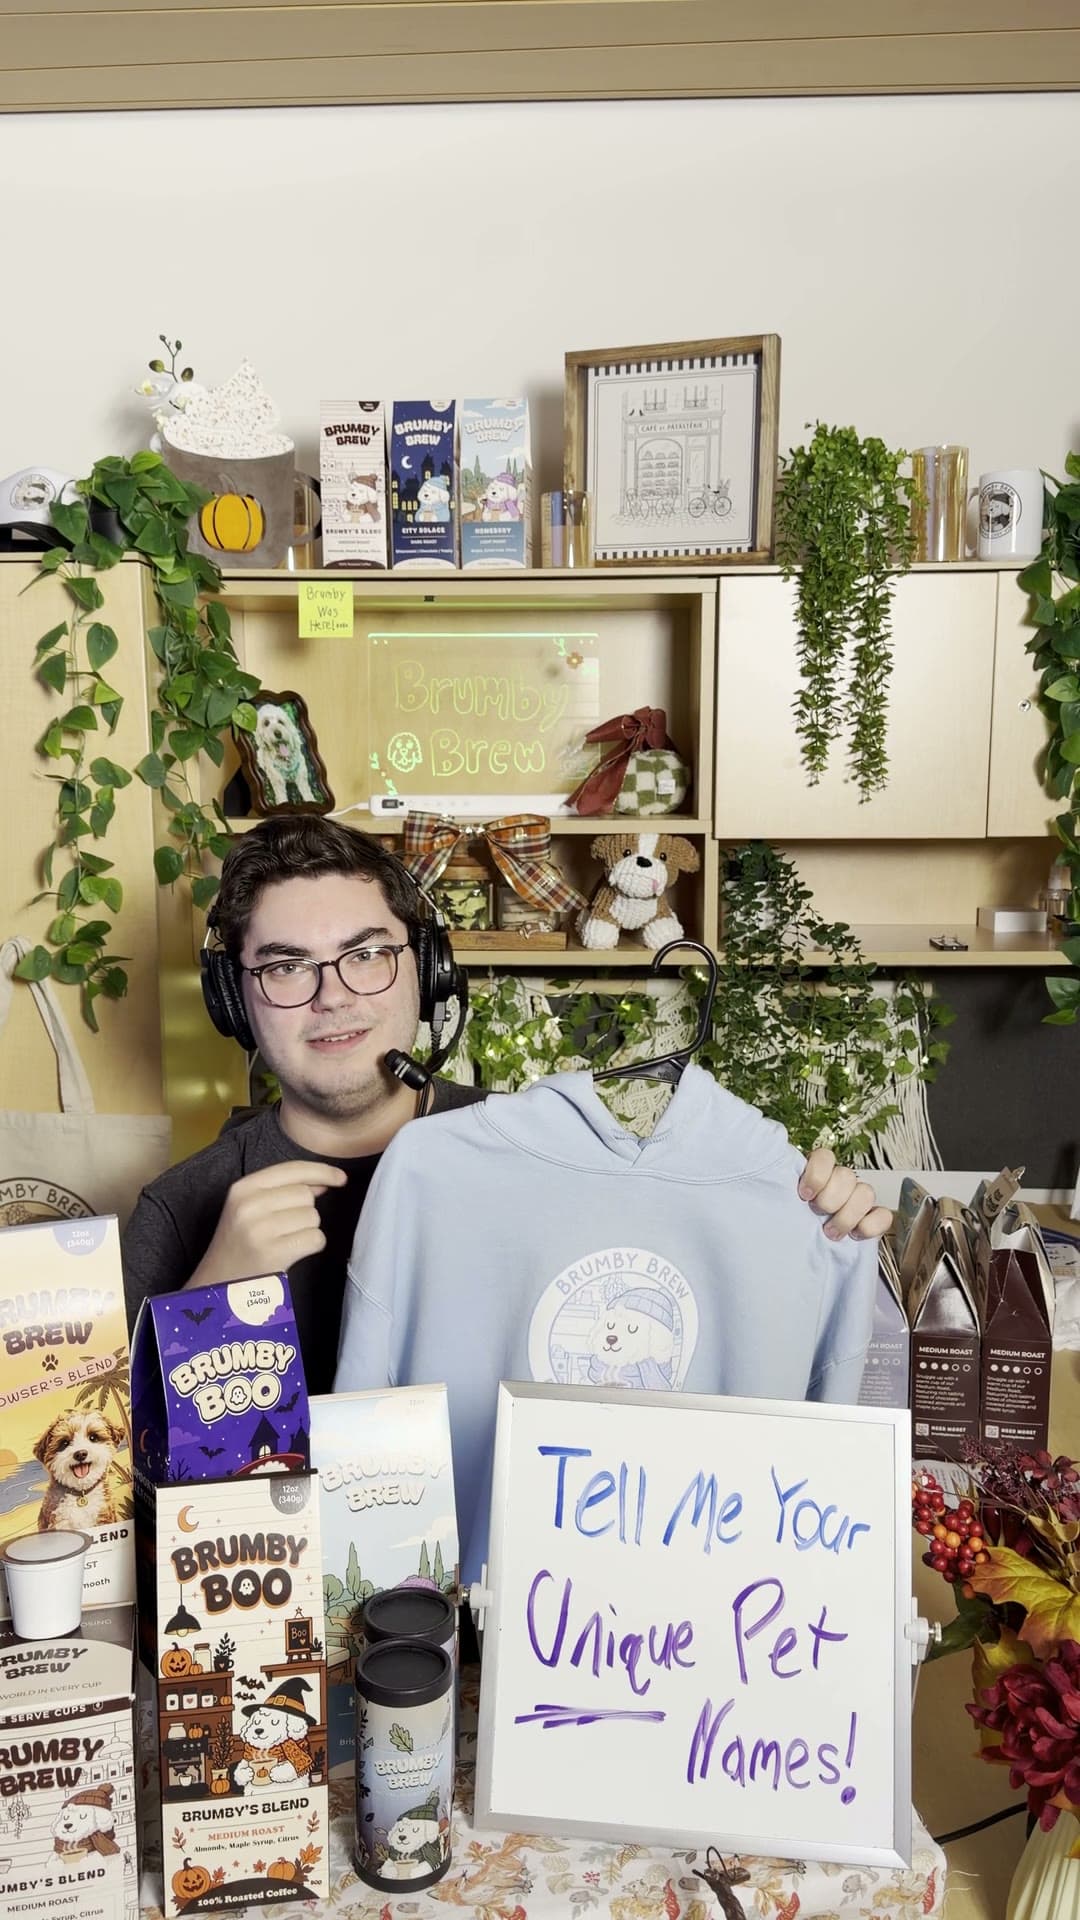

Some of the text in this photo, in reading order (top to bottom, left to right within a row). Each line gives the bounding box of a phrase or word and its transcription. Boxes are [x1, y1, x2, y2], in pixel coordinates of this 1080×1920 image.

[324, 424, 380, 436] BRUMBY
[394, 419, 454, 435] BRUMBY
[336, 435, 371, 446] BREW
[405, 433, 441, 446] BREW
[393, 660, 568, 732] Brumby
[430, 728, 545, 776] Brew
[556, 1252, 690, 1300] BRUMBY BREW
[249, 1290, 265, 1298] 12oz
[5, 1320, 93, 1356] BREW
[919, 1346, 973, 1356] MEDIUM ROAST
[990, 1349, 1020, 1358] MEDIUM
[68, 1358, 112, 1382] BLEND
[171, 1342, 296, 1396] BRUMBY
[195, 1372, 281, 1423] BOO
[282, 1484, 299, 1494] 12oz
[345, 1483, 426, 1513] BREW
[279, 1494, 304, 1505] (340g)
[537, 1445, 871, 1555] Tell Me Your
[171, 1533, 308, 1584] BRUMBY
[201, 1568, 293, 1616] BOO
[291, 1626, 307, 1640] Boo
[527, 1569, 850, 1696] Unique Pet
[5, 1662, 71, 1680] BREW
[10, 1710, 50, 1724] SERVE
[54, 1704, 87, 1718] CUPS
[687, 1697, 858, 1805] Names!
[375, 1753, 443, 1776] BRUMBY
[0, 1766, 83, 1797] BREW
[387, 1772, 433, 1790] BREW
[182, 1797, 309, 1823] BRUMBY'S BLEND
[208, 1825, 285, 1842] MEDIUM ROAST
[229, 1841, 251, 1851] Maple
[277, 1835, 300, 1844] Citrus
[58, 1868, 106, 1885] BLEND
[7, 1895, 80, 1913] MEDIUM ROAST
[197, 1886, 299, 1907] 100% Roasted Coffee
